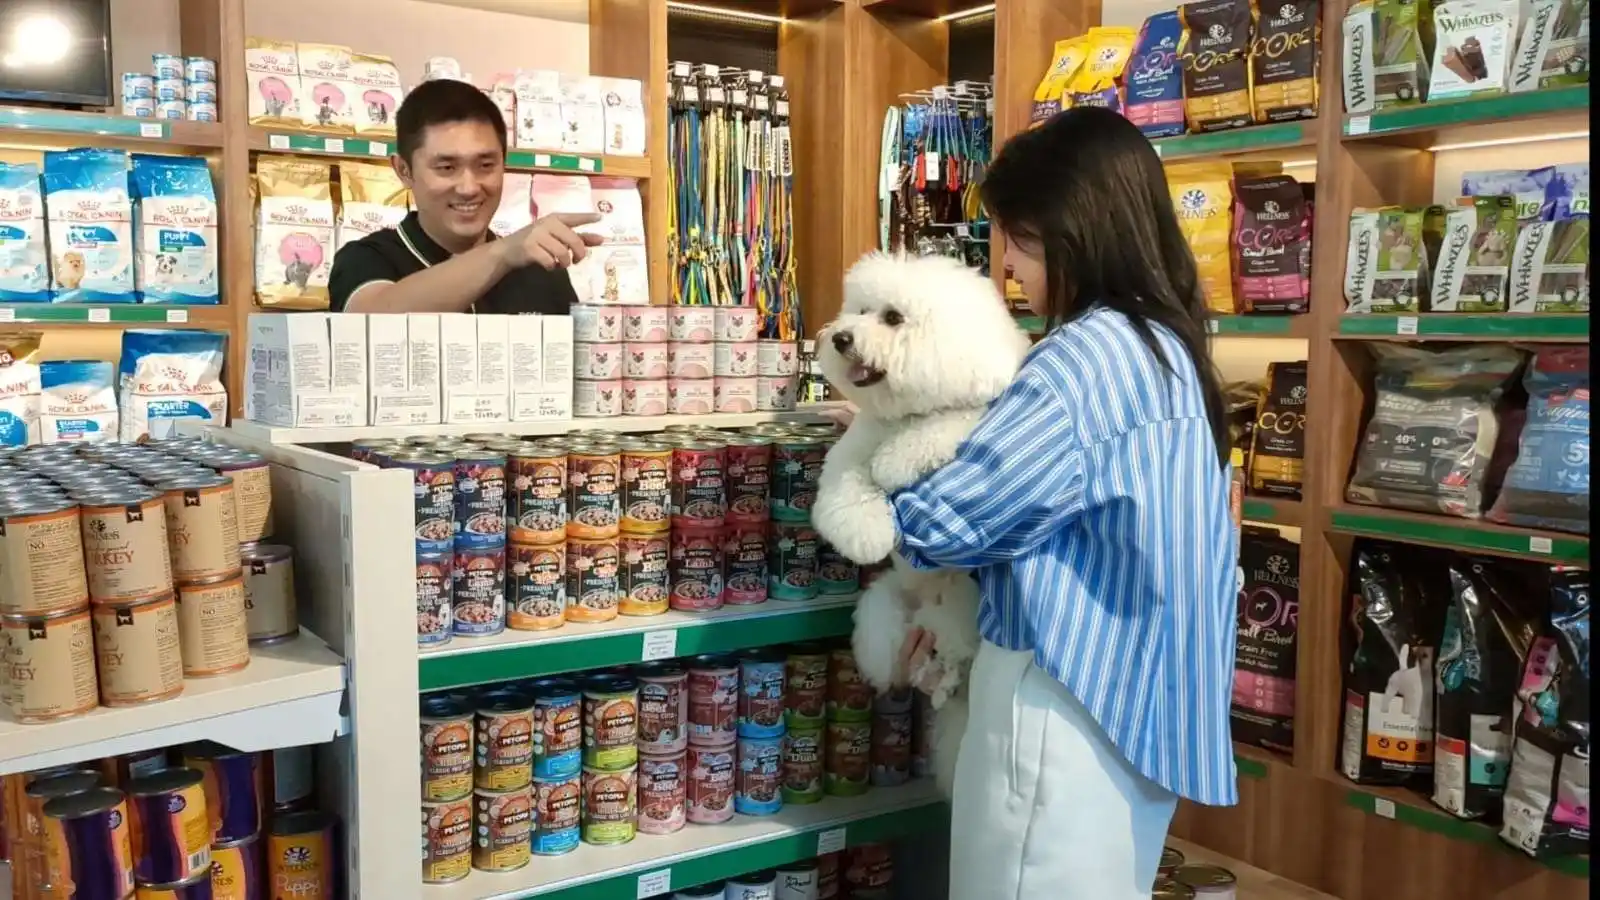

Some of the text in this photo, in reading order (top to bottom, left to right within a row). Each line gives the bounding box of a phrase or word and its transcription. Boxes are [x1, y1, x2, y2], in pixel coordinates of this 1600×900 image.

[1438, 12, 1504, 33] WHIMZEES
[1252, 27, 1311, 58] CORE
[1515, 3, 1554, 87] WHIMZEES
[1350, 23, 1365, 108] WHIMZEES
[164, 231, 190, 242] PUPPY
[1239, 225, 1297, 249] CORE
[1352, 230, 1371, 308] WHIMZEES
[1436, 223, 1470, 305] WHIMZEES
[1515, 222, 1548, 307] WHIMZEES
[1259, 411, 1306, 434] COR
[1395, 434, 1417, 444] 40%
[30, 541, 45, 550] NO
[685, 558, 715, 568] Lamb
[607, 717, 633, 726] PETOPIA
[502, 735, 529, 745] PETOPIA
[438, 742, 467, 752] PETOPIA
[596, 793, 624, 801] PETOPIA
[552, 799, 576, 809] PETOPIA
[504, 813, 529, 824] PETOPIA
[444, 824, 470, 834] PETOPIA
[275, 873, 320, 897] Puppy
